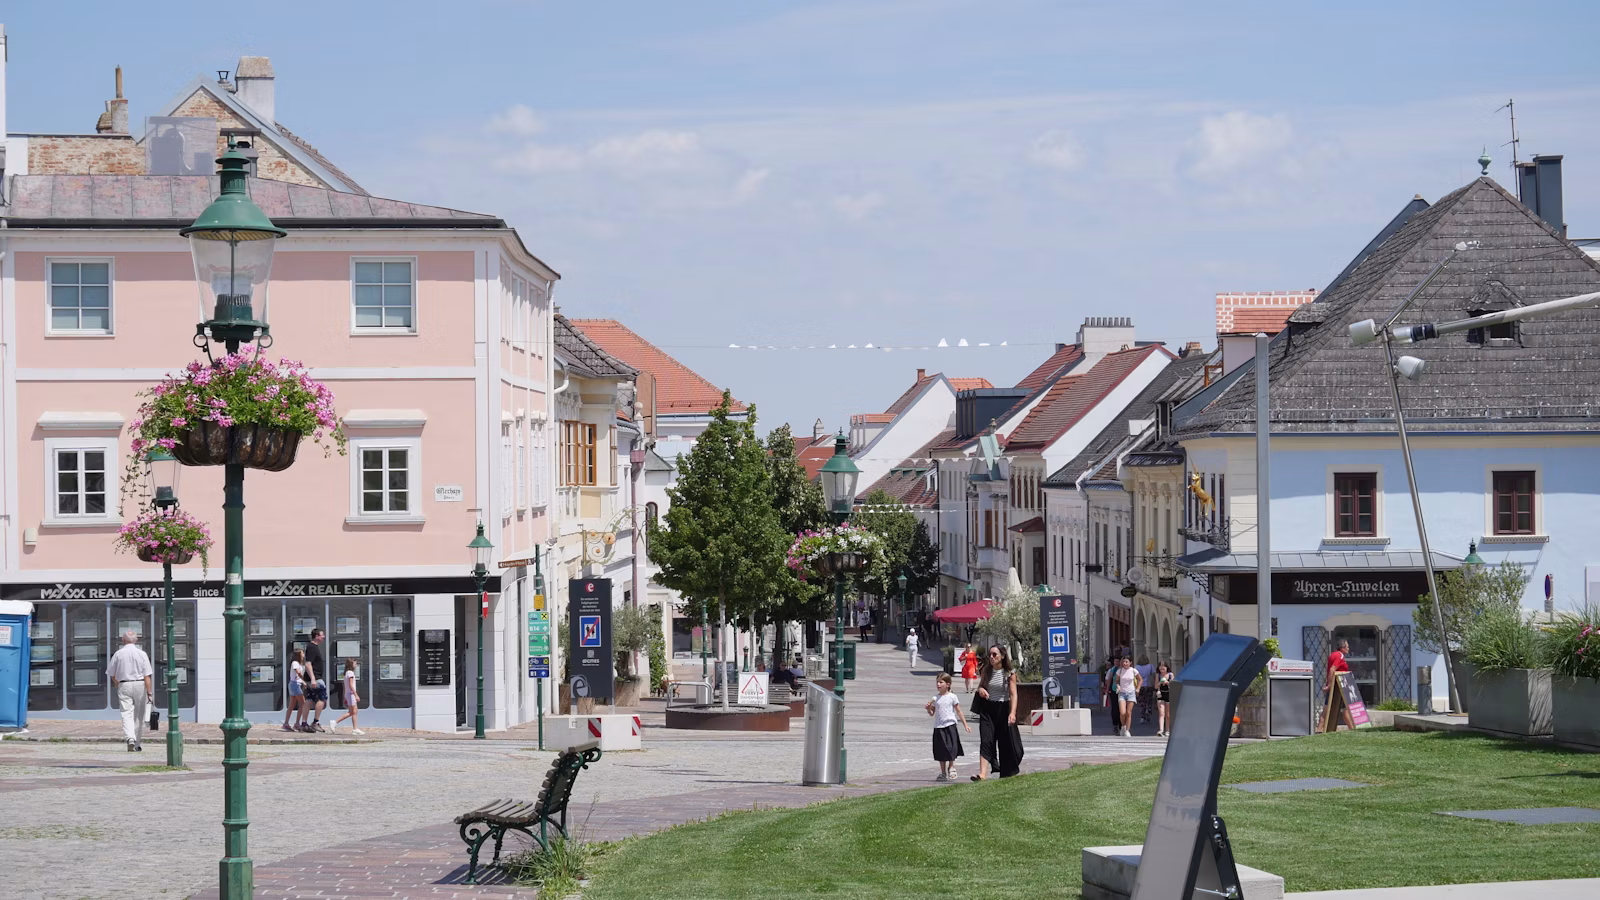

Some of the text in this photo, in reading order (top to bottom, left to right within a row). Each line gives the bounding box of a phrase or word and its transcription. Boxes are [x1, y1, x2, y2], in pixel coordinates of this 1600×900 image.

[89, 588, 123, 598] REAL
[193, 588, 219, 597] since
[309, 585, 341, 595] REAL
[344, 584, 392, 595] ESTATE
